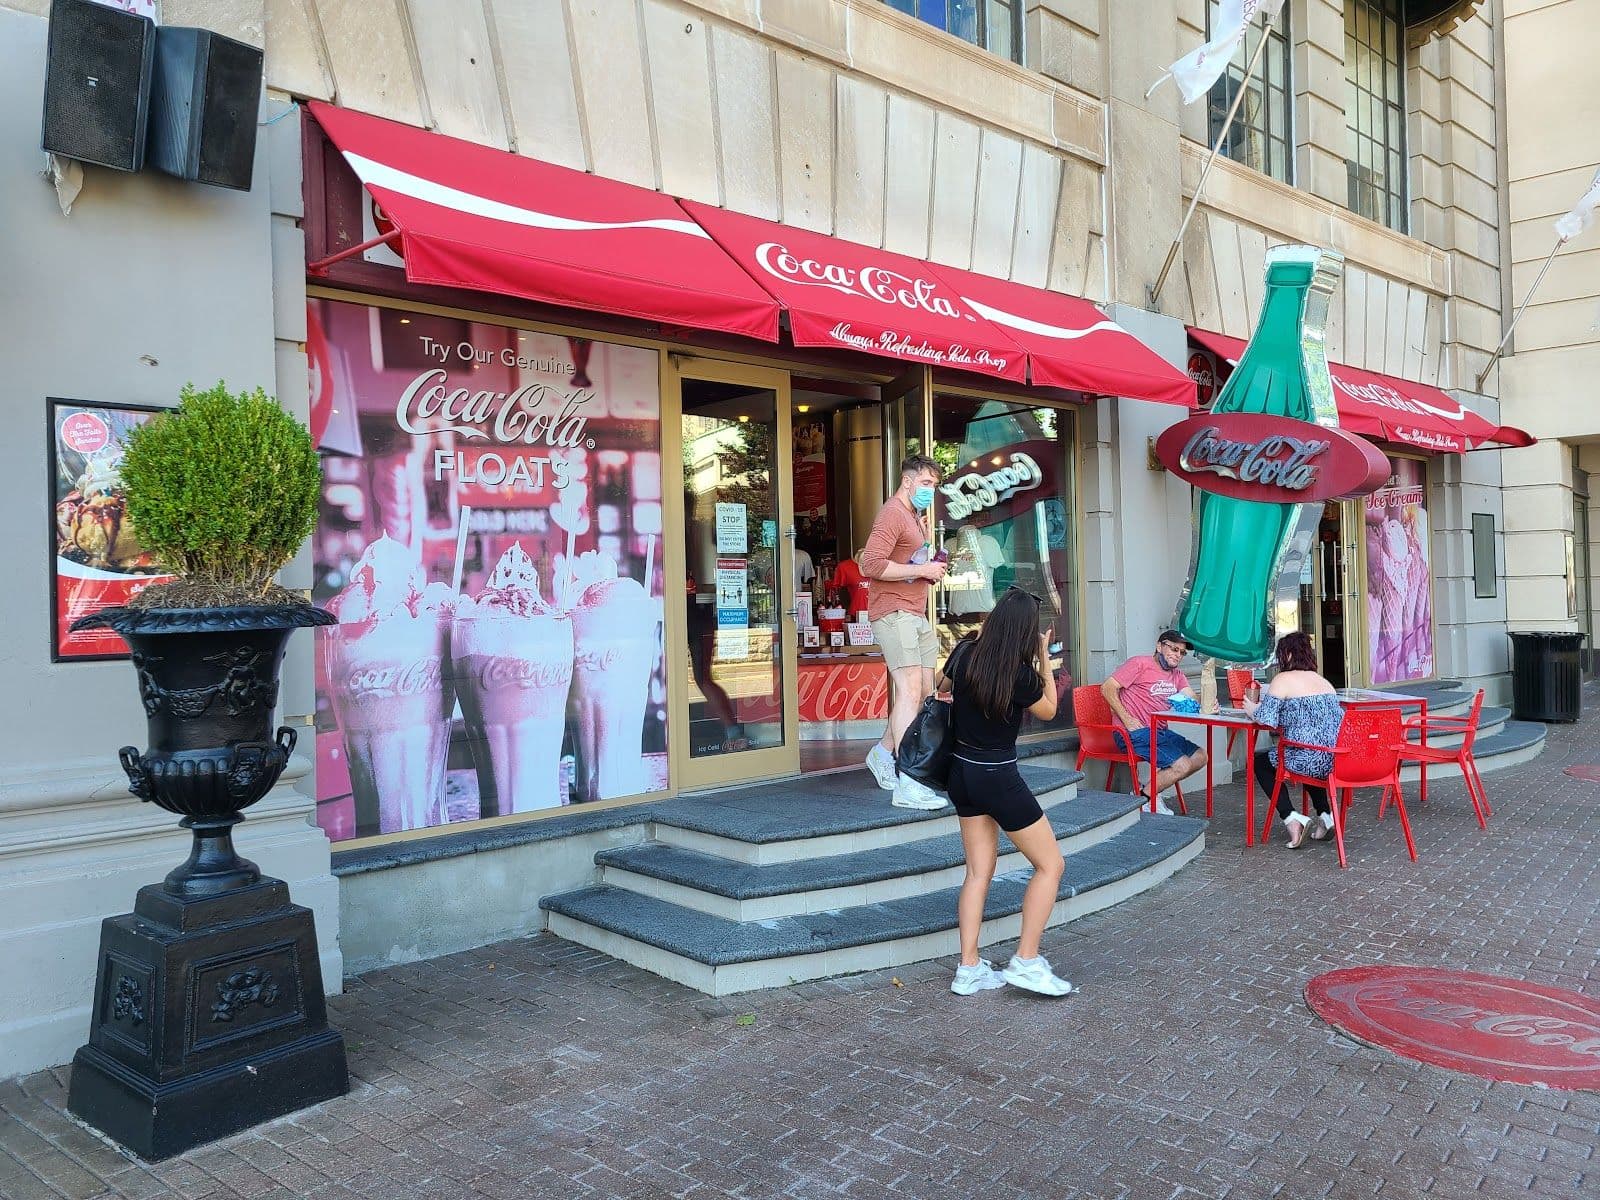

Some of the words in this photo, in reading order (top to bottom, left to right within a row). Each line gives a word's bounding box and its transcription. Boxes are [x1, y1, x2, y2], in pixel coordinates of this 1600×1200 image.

[755, 242, 960, 318] Coca-Cola
[419, 336, 451, 363] Try
[457, 343, 495, 364] Our
[500, 348, 577, 376] Genuine
[830, 322, 874, 350] Always
[876, 331, 943, 363] Refreshing
[973, 350, 1007, 371] Shop
[396, 368, 597, 449] Coca-Cola
[433, 449, 571, 490] FLOATS
[1179, 426, 1331, 491] Coca-Cola
[1388, 490, 1423, 508] Cream
